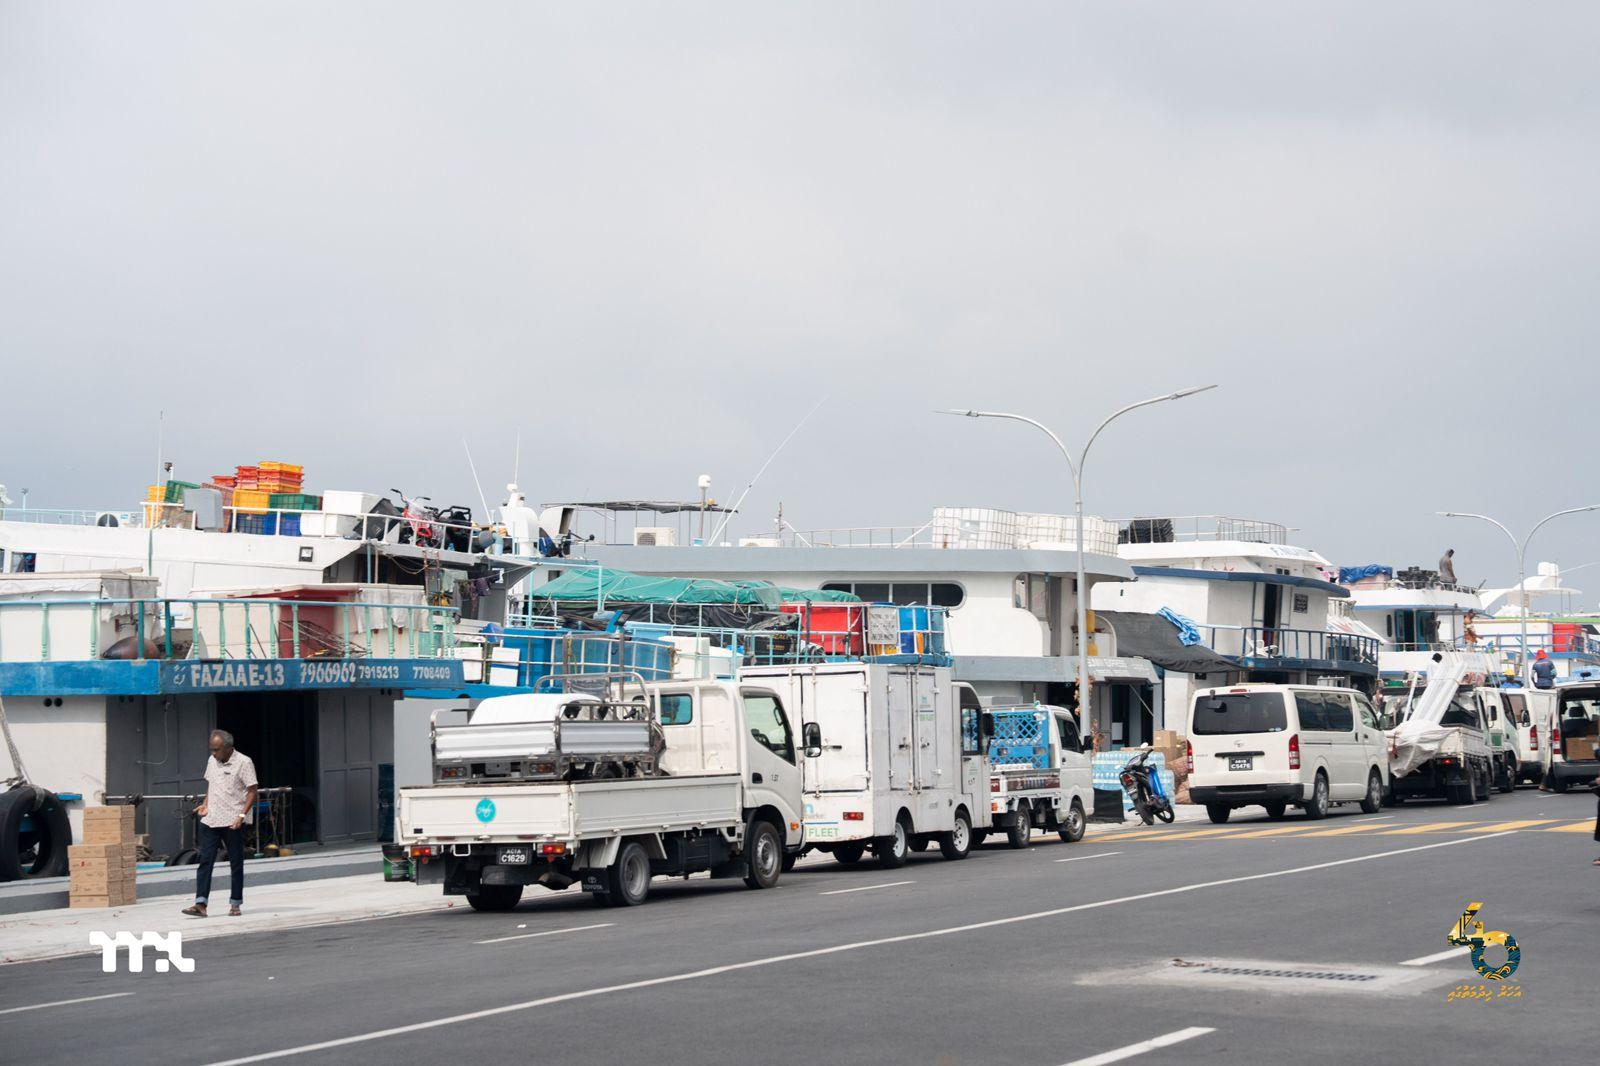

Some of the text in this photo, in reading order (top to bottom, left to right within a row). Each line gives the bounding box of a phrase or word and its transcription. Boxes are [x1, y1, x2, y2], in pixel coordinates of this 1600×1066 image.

[299, 662, 357, 683] 7966962
[358, 665, 400, 679] 7915213
[808, 827, 840, 838] FLEET
[501, 854, 526, 863] C1629
